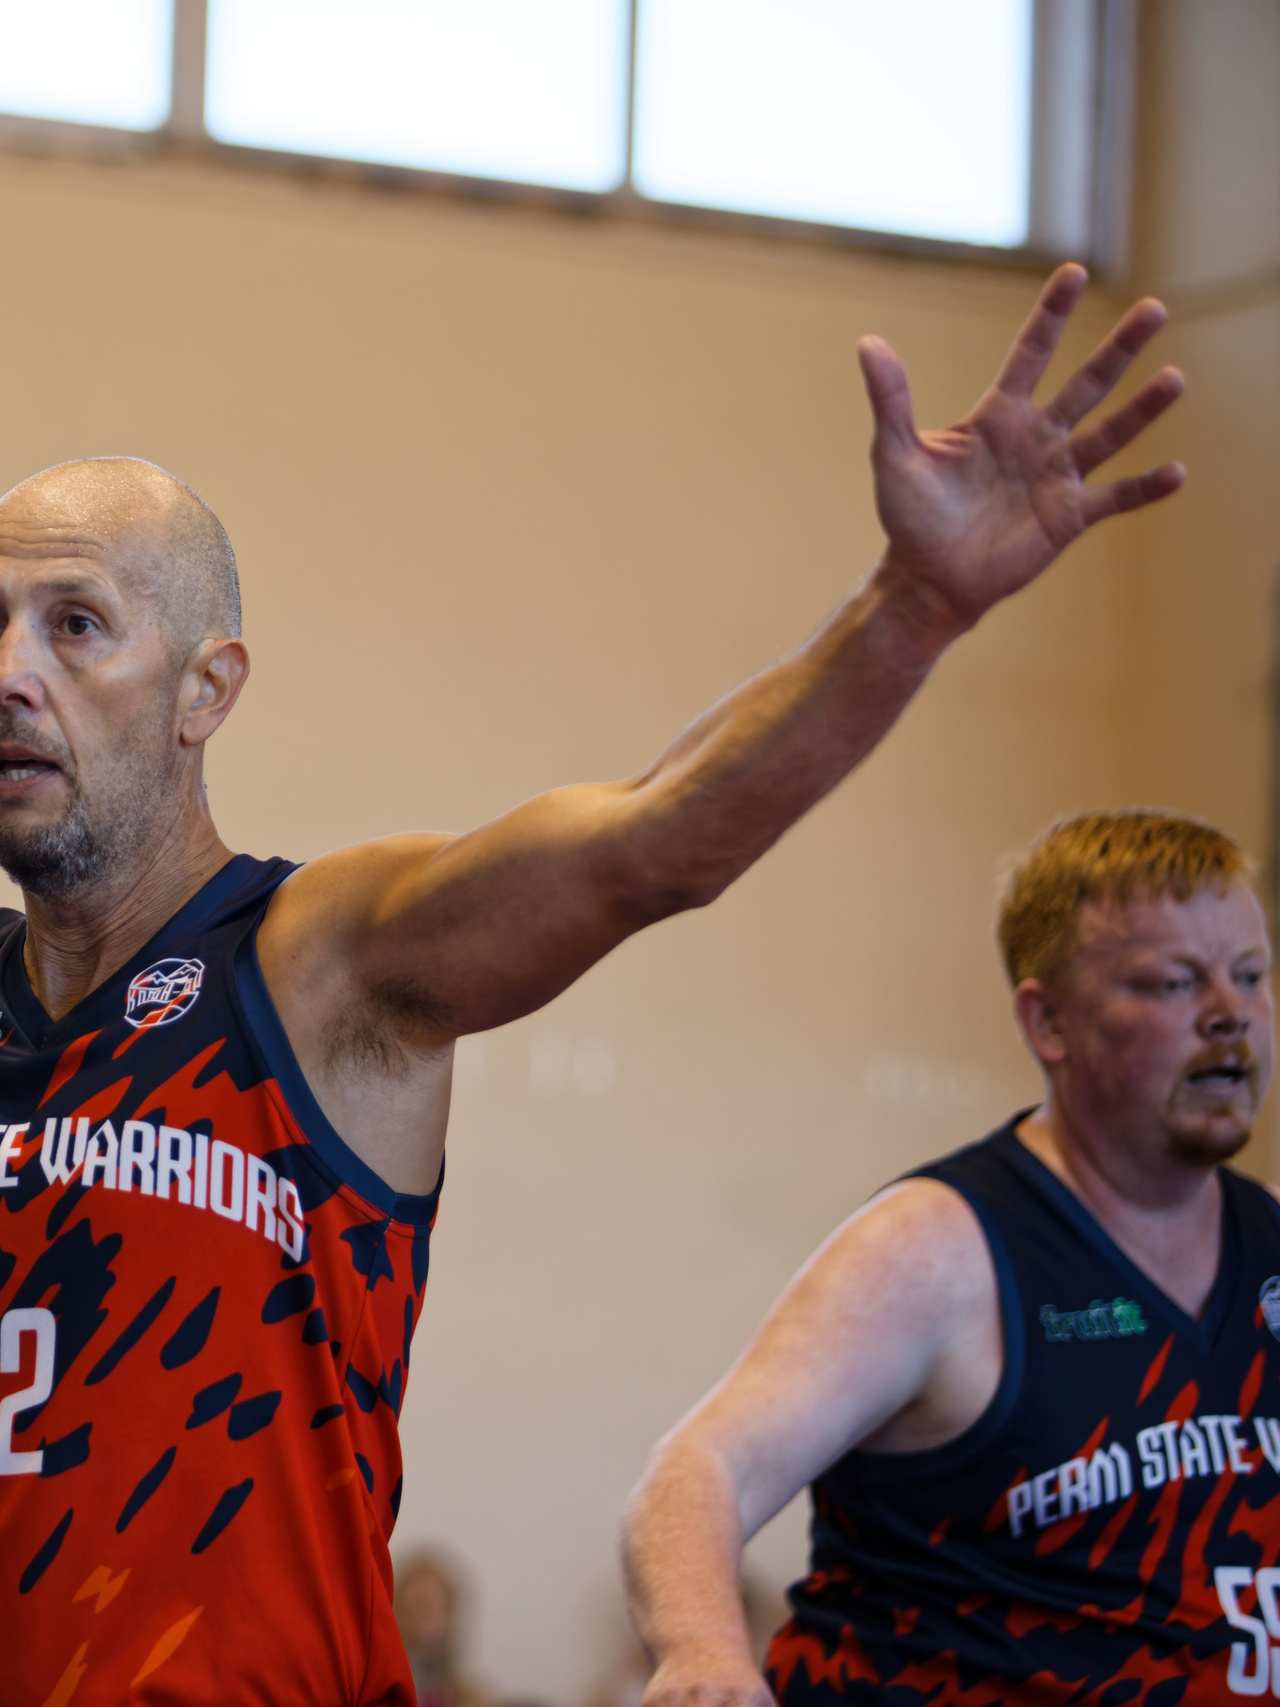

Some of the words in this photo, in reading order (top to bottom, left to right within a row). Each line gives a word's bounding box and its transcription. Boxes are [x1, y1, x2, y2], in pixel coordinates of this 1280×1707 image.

[39, 1117, 306, 1263] WARRIORS
[1007, 1441, 1134, 1538] PERM
[1136, 1414, 1254, 1489] STATE
